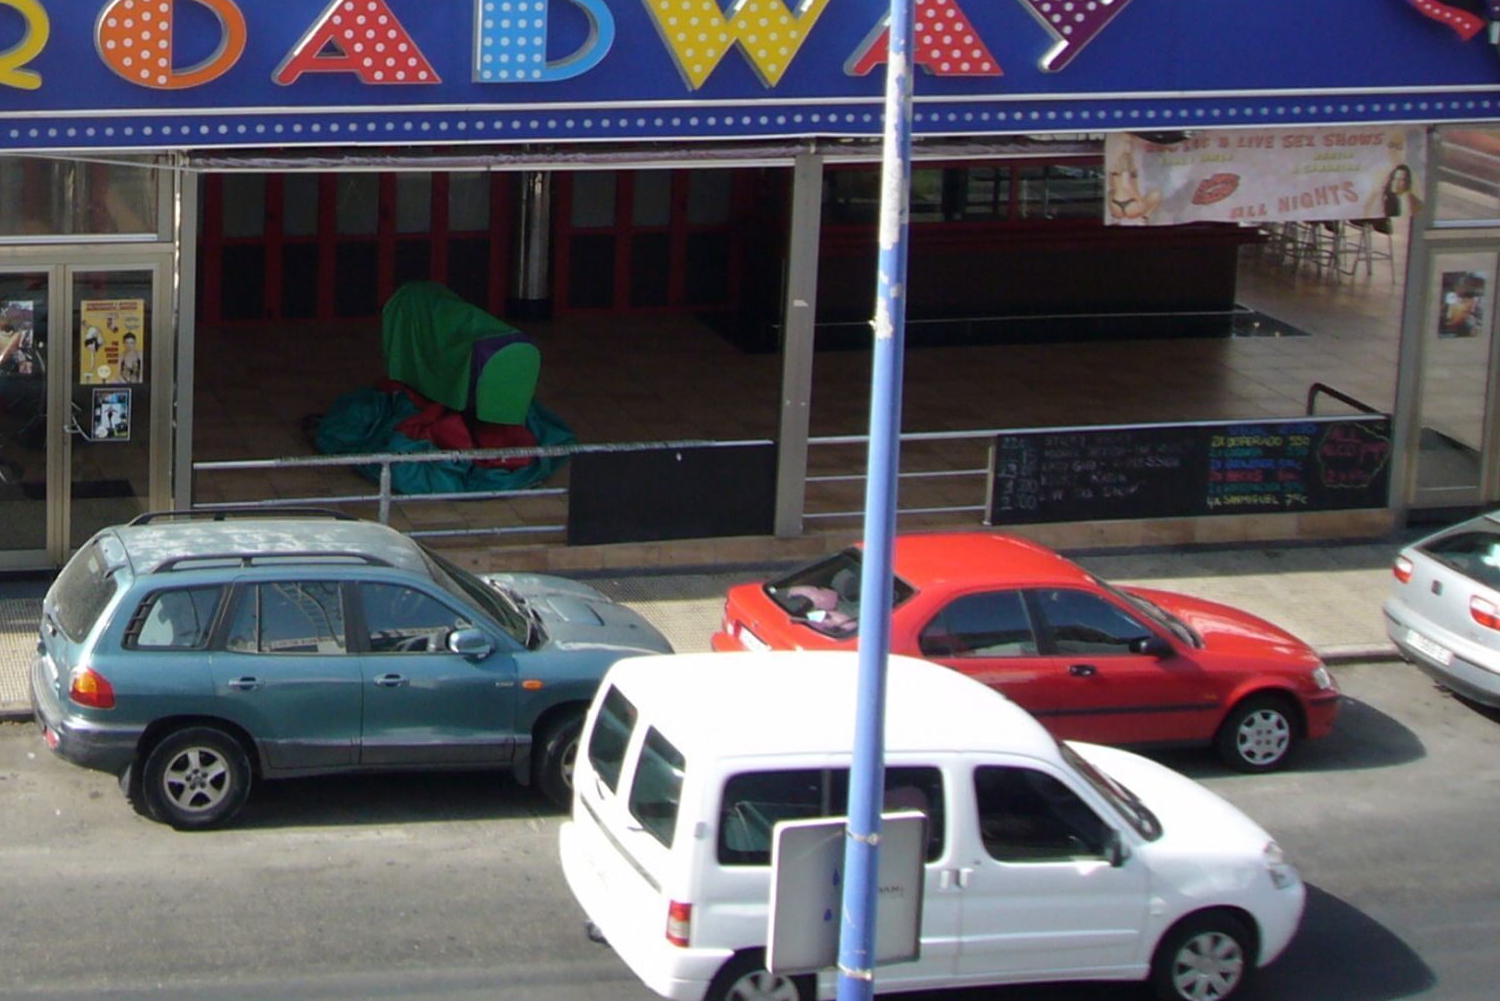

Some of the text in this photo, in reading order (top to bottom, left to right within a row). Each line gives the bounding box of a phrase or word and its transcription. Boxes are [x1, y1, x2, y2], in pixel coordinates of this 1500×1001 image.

[1236, 134, 1275, 149] LIVE
[1282, 134, 1316, 149] SEX
[1322, 132, 1385, 147] SHOWS
[1229, 180, 1359, 219] ALL NIGHTS
